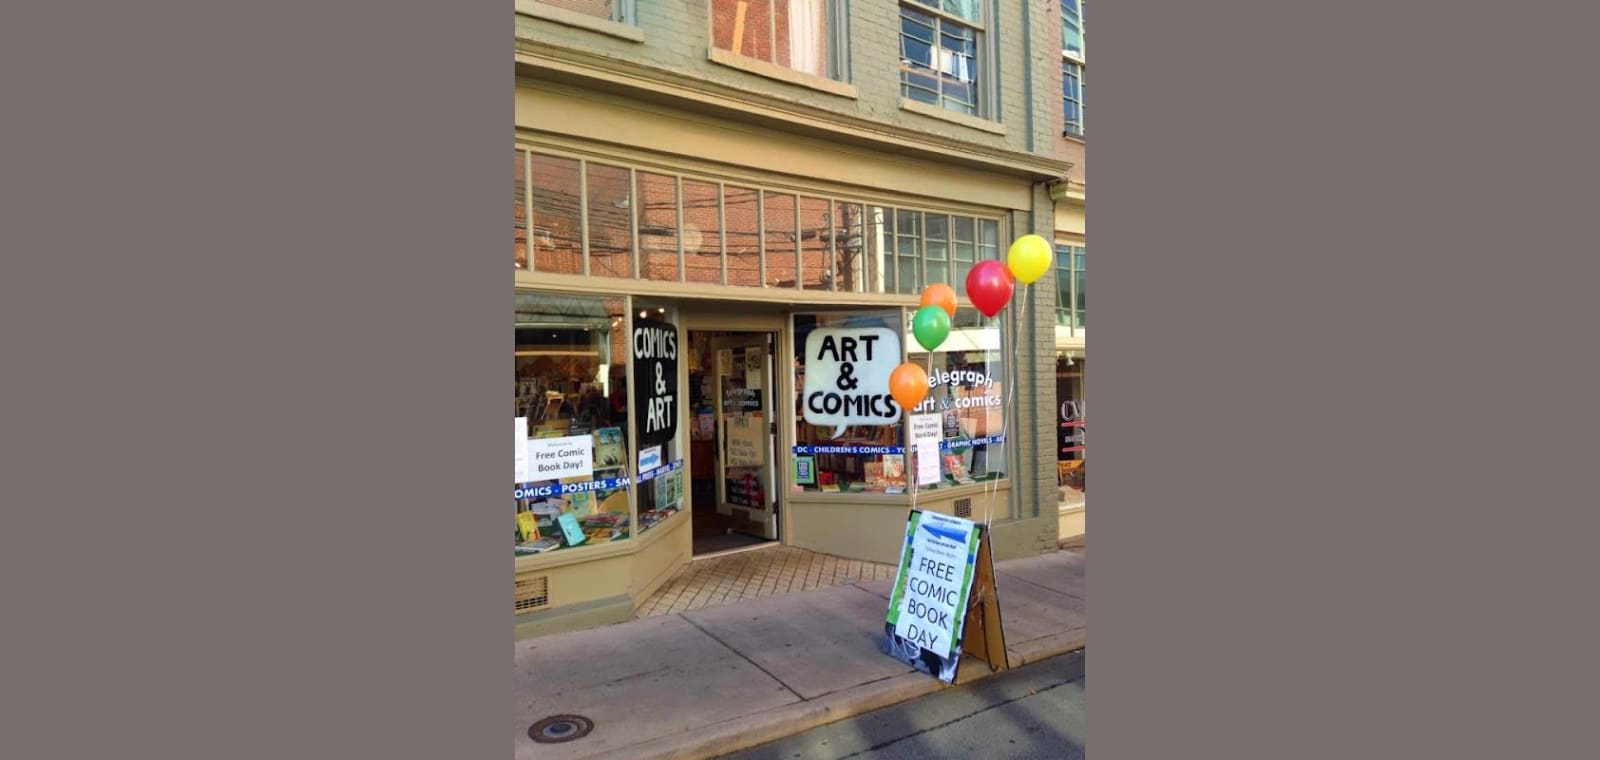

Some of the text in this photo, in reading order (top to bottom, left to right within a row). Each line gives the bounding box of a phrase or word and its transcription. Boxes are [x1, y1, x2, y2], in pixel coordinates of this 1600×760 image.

[634, 327, 677, 360] COMICS
[817, 335, 879, 362] ART
[655, 361, 667, 395] &
[836, 362, 858, 391] &
[928, 367, 993, 388] elegraph
[808, 391, 897, 418] COMICS
[955, 391, 1001, 408] comics
[646, 395, 674, 433] ART
[535, 448, 585, 460] Free Comic
[538, 460, 584, 472] Book Day!
[561, 480, 607, 493] POSTERS
[919, 557, 955, 582] FREE
[909, 577, 958, 607] COMIC
[907, 599, 948, 630] BOOK
[907, 624, 939, 650] DAY
